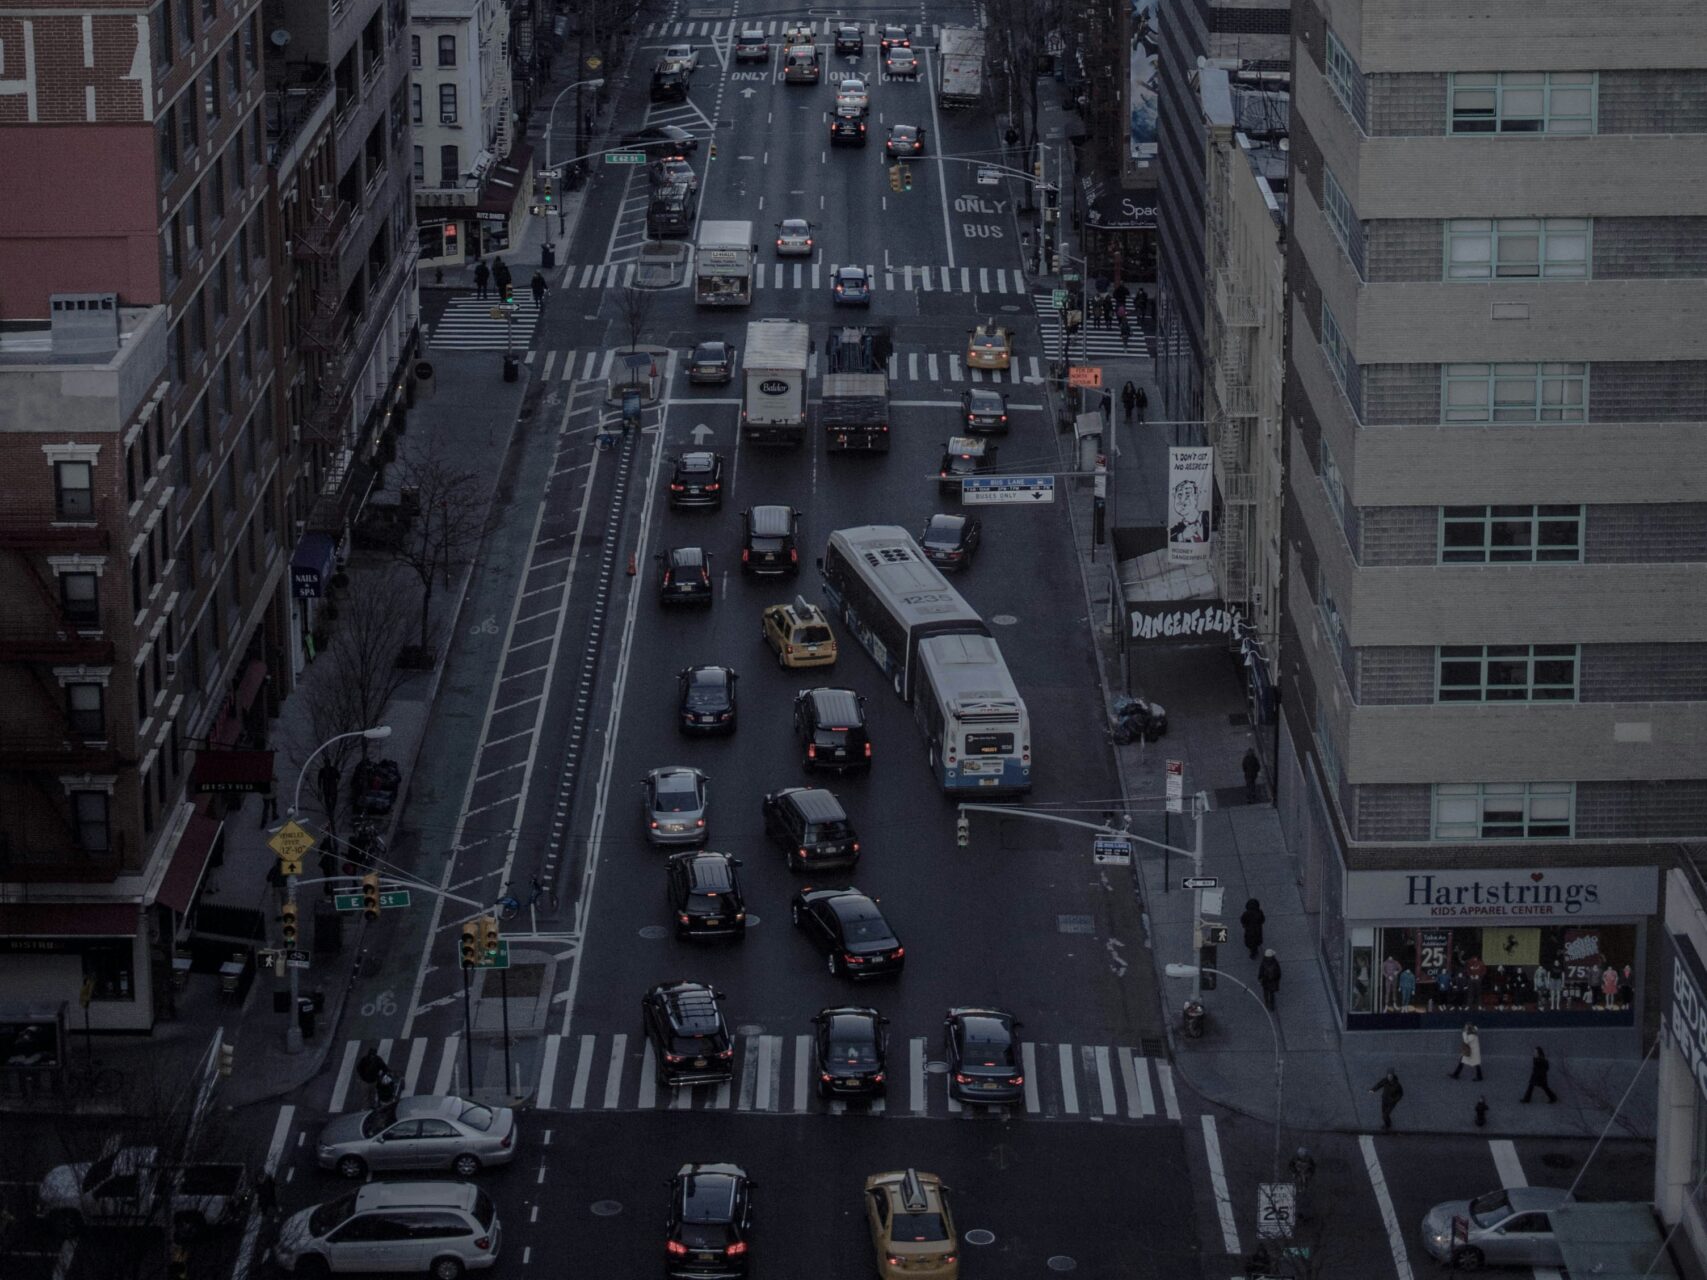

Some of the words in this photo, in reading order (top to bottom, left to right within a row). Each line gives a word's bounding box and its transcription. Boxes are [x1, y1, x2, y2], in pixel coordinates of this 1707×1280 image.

[731, 71, 768, 81] ONLY
[829, 71, 871, 81] ONLY
[954, 198, 1007, 214] ONLY
[963, 223, 1004, 238] BUS
[762, 382, 787, 393] Baldor
[990, 479, 1004, 487] BUS
[1007, 478, 1024, 486] LANE
[295, 574, 319, 583] NAILS
[299, 588, 315, 597] SPA
[1130, 605, 1242, 640] DANGERFIELD'S
[1405, 874, 1599, 914] Hartstrings
[351, 897, 360, 907] E
[380, 895, 394, 905] St
[1431, 906, 1456, 916] KIDS
[1460, 906, 1509, 915] APPAREL
[1511, 905, 1553, 915] CENTER
[1673, 956, 1699, 1031] BED
[1263, 1206, 1290, 1221] 25
